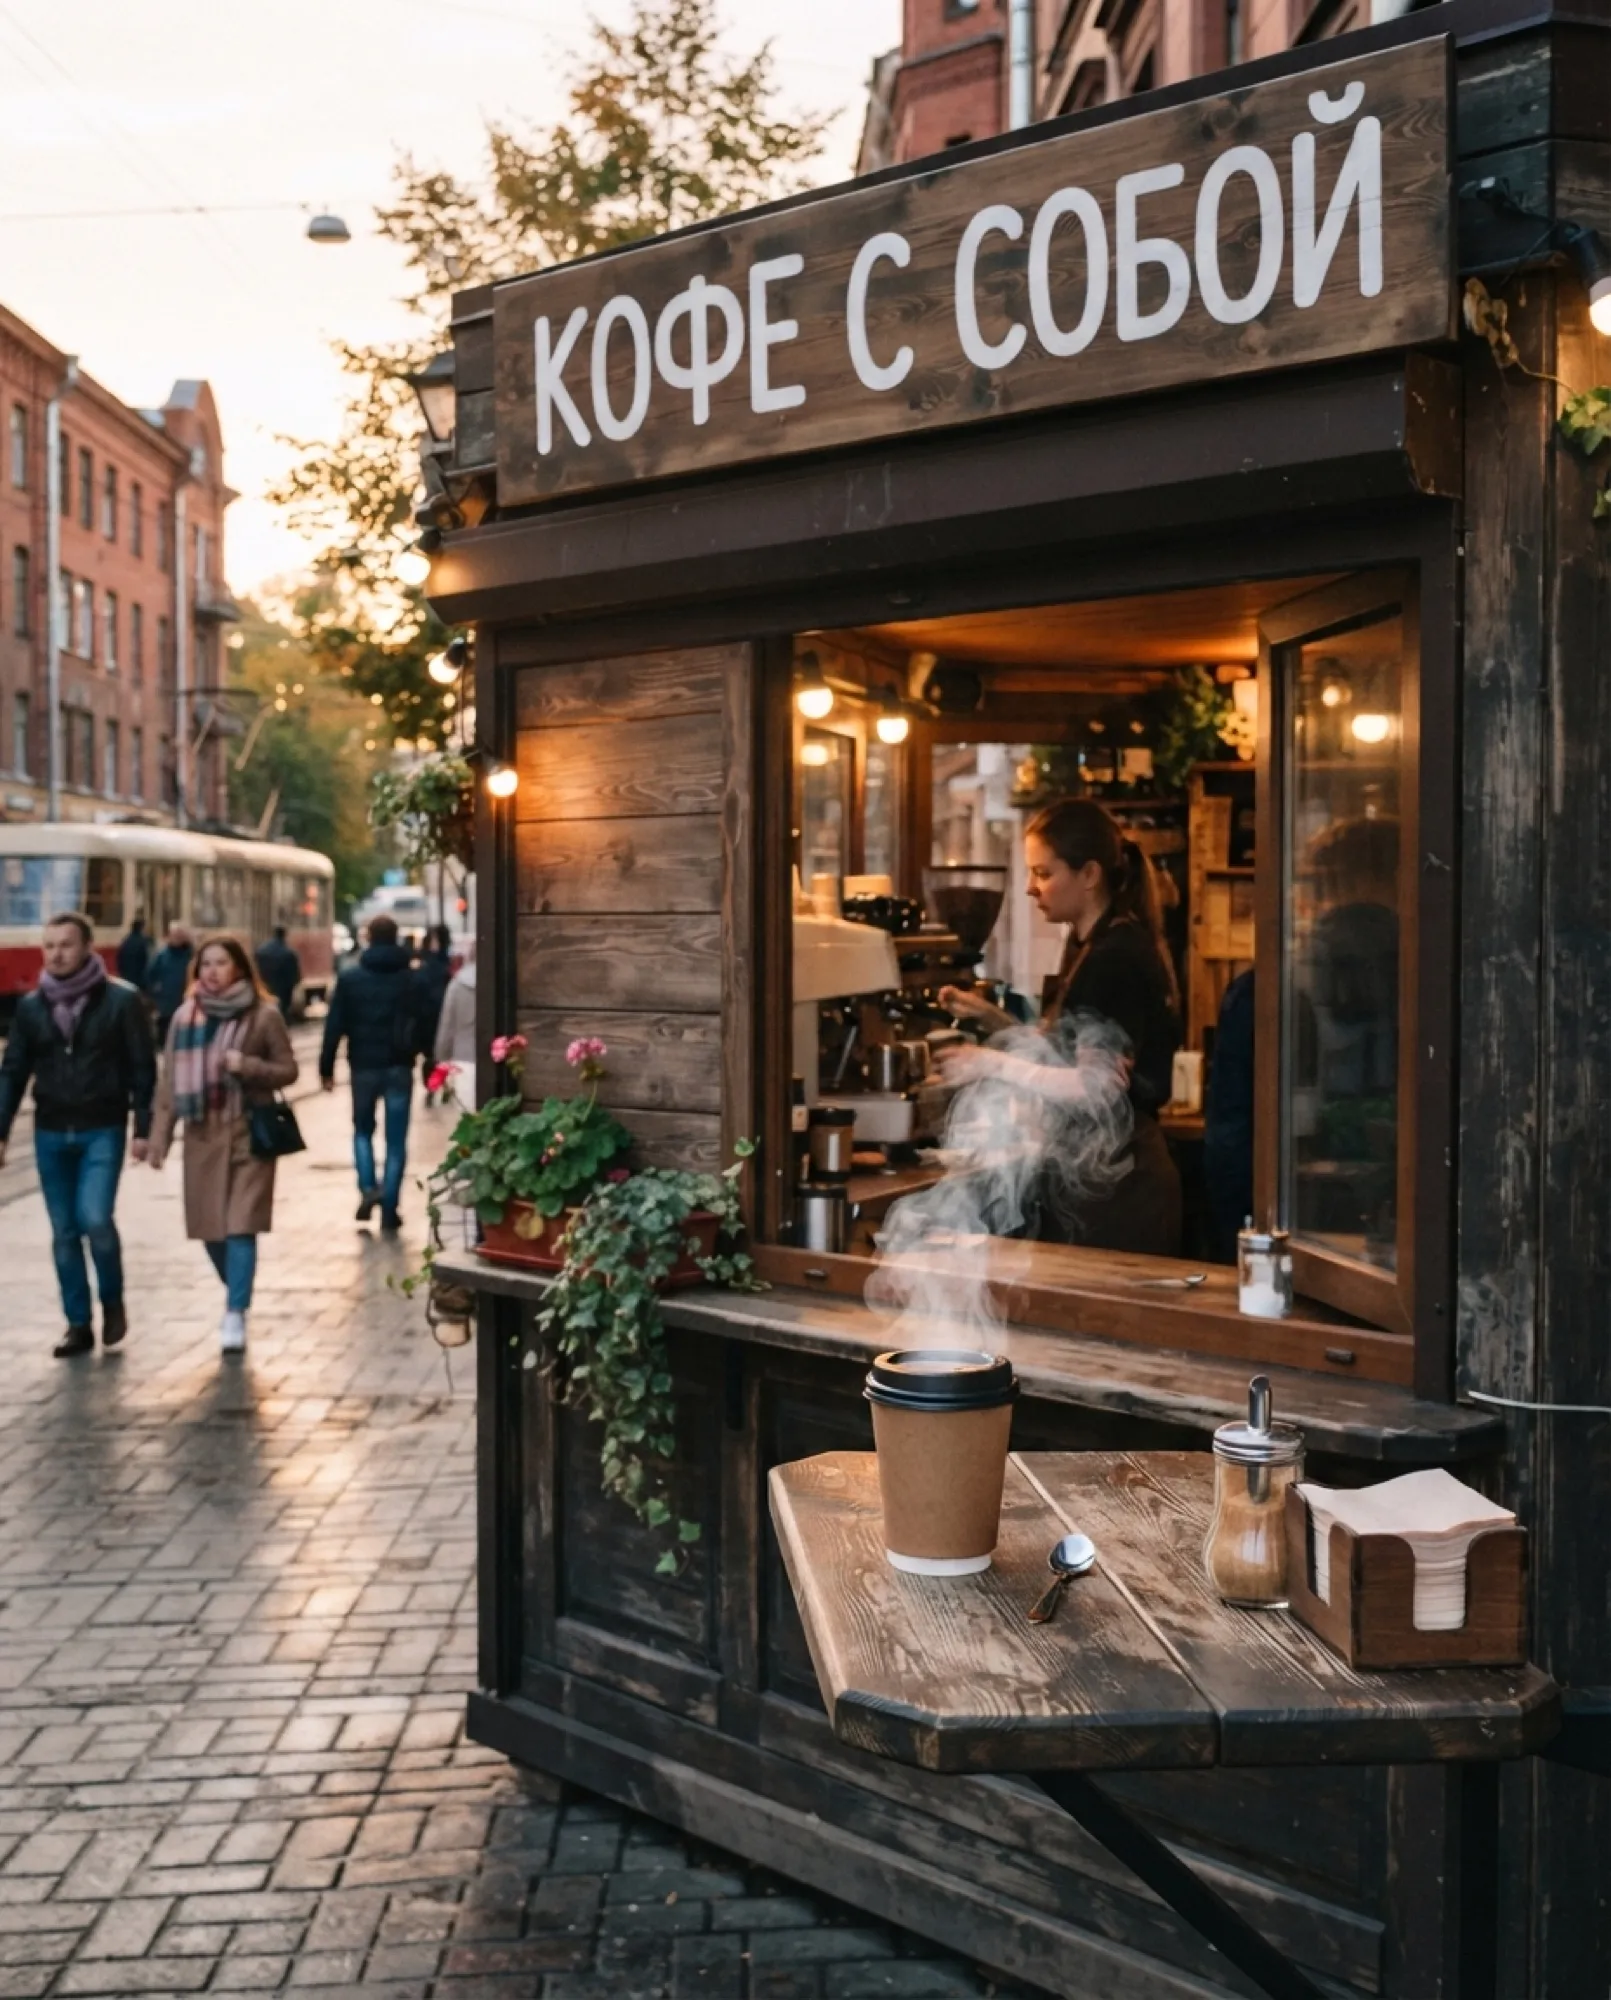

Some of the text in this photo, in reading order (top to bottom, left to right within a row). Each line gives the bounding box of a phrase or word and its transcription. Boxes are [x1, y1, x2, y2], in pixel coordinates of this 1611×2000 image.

[533, 81, 1383, 456] КОФЕ С СОБОЙ
